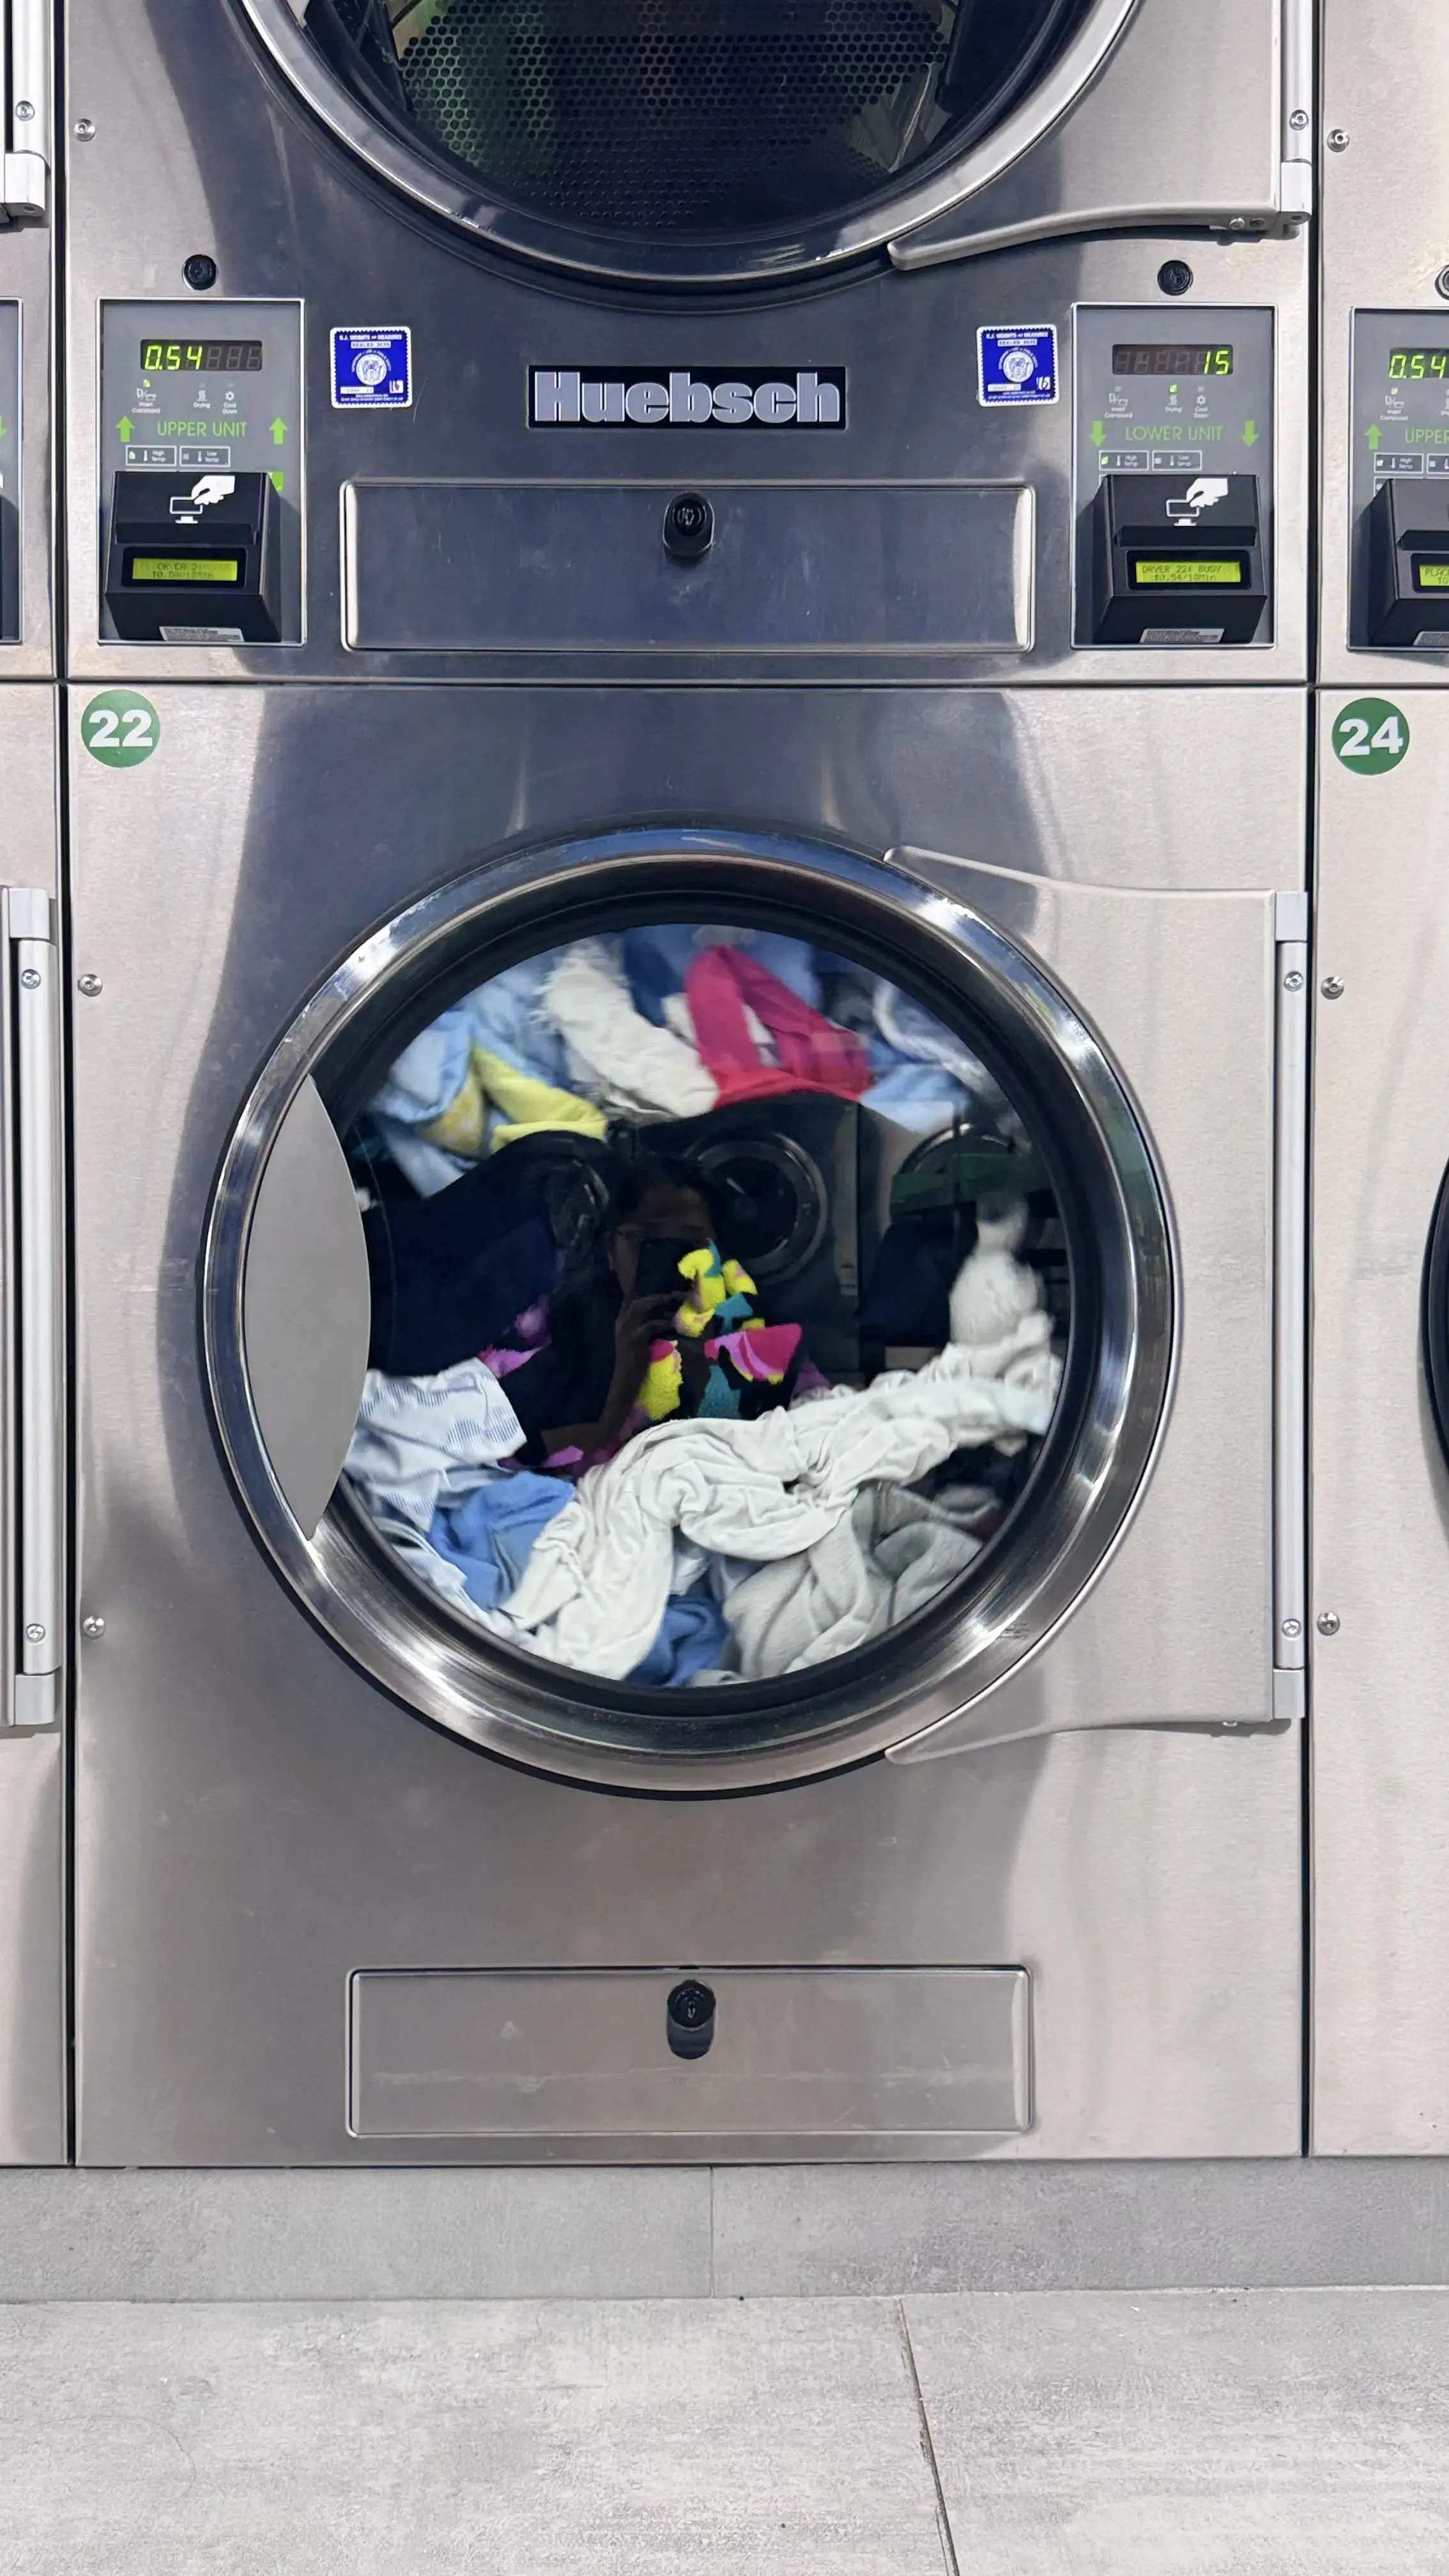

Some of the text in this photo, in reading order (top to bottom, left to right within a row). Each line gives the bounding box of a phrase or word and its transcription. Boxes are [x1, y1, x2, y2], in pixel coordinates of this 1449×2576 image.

[144, 345, 203, 371] 0.54
[1203, 350, 1230, 375] 15
[1388, 354, 1447, 379] 0.54
[534, 371, 841, 424] Huebsch
[157, 420, 248, 438] UPPER UNIT
[1125, 425, 1223, 441] LOWER UNIT
[89, 709, 153, 747] 22
[1338, 716, 1404, 757] 24
